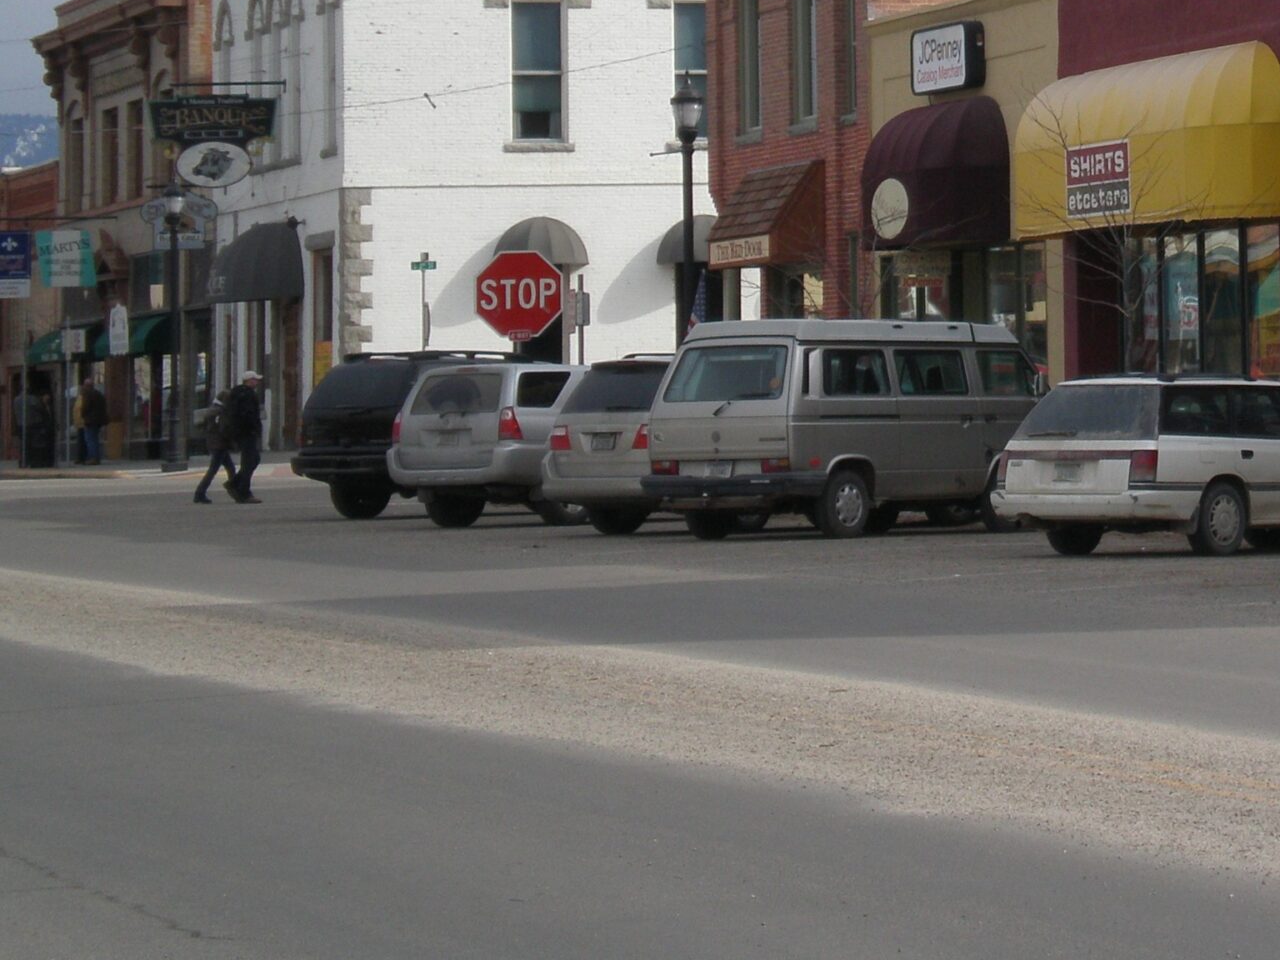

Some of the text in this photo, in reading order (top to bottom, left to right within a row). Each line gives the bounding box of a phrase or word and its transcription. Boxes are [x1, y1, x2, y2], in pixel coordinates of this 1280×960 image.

[918, 38, 962, 65] JCPenney
[1070, 150, 1125, 178] SHIRTS
[1069, 188, 1129, 211] etcetera
[480, 278, 557, 310] STOP
